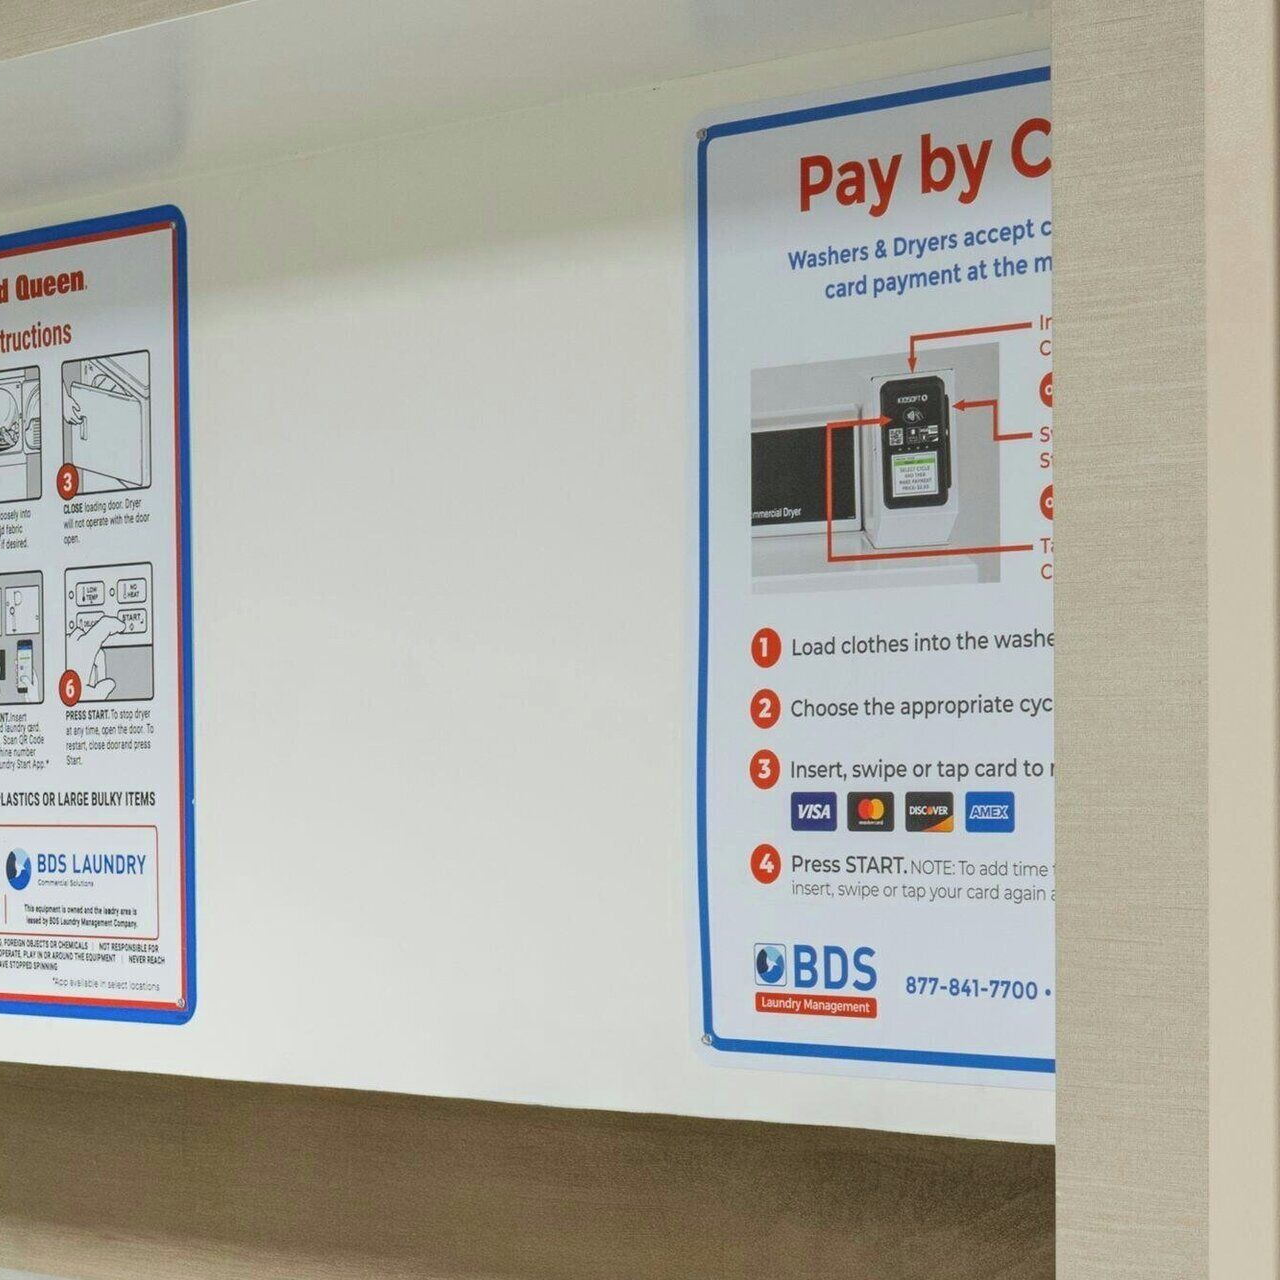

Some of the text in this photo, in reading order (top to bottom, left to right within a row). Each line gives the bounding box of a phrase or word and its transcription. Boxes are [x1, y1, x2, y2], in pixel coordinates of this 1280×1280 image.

[800, 154, 902, 217] Pay
[920, 133, 992, 204] by
[788, 243, 869, 270] Washers
[875, 239, 888, 259] &
[893, 231, 958, 258] Dryers
[964, 218, 1034, 247] accept
[16, 270, 85, 302] Queen
[825, 275, 867, 298] card
[873, 263, 962, 298] payment
[967, 260, 988, 280] at
[994, 255, 1028, 278] the
[63, 473, 72, 492] 3
[64, 503, 82, 514] CLOSE
[84, 502, 106, 514] loading
[125, 498, 141, 510] Dryer
[64, 512, 150, 530] will not operate with the door
[759, 637, 768, 658] 1
[792, 636, 836, 656] Load
[841, 635, 909, 654] clothes
[914, 632, 951, 652] into
[956, 631, 989, 650] the
[66, 684, 74, 698] 6
[66, 710, 86, 720] PRESS
[111, 709, 118, 720] To
[120, 710, 133, 721] stop
[135, 708, 150, 720] dryer
[758, 698, 772, 718] 2
[791, 700, 859, 718] Choose
[864, 698, 895, 716] the
[900, 694, 1014, 719] appropriate
[758, 758, 771, 778] 3
[790, 760, 848, 782] Insert,
[852, 759, 907, 782] swipe
[912, 762, 932, 778] or
[938, 761, 969, 782] tap
[974, 758, 1018, 778] card
[1023, 760, 1044, 777] to
[42, 792, 56, 806] OR
[58, 792, 88, 806] LARGE
[92, 792, 123, 806] BULKY
[125, 792, 156, 806] ITEMS
[798, 804, 831, 819] VISA
[909, 806, 948, 816] DISCOVER
[970, 805, 1009, 819] AMEX
[37, 854, 146, 875] BDS LAUNDRY
[759, 852, 774, 873] 4
[792, 854, 840, 874] Press
[846, 856, 908, 874] START.
[910, 860, 956, 876] NOTE:
[958, 860, 976, 876] To
[980, 860, 1009, 876] add
[1012, 861, 1048, 877] time
[38, 878, 68, 886] Commercial
[792, 880, 1048, 904] insert, swipe or tap your card again
[793, 944, 878, 992] BDS
[906, 976, 1038, 1000] 877-841-7700
[762, 996, 870, 1014] Laundry Management
